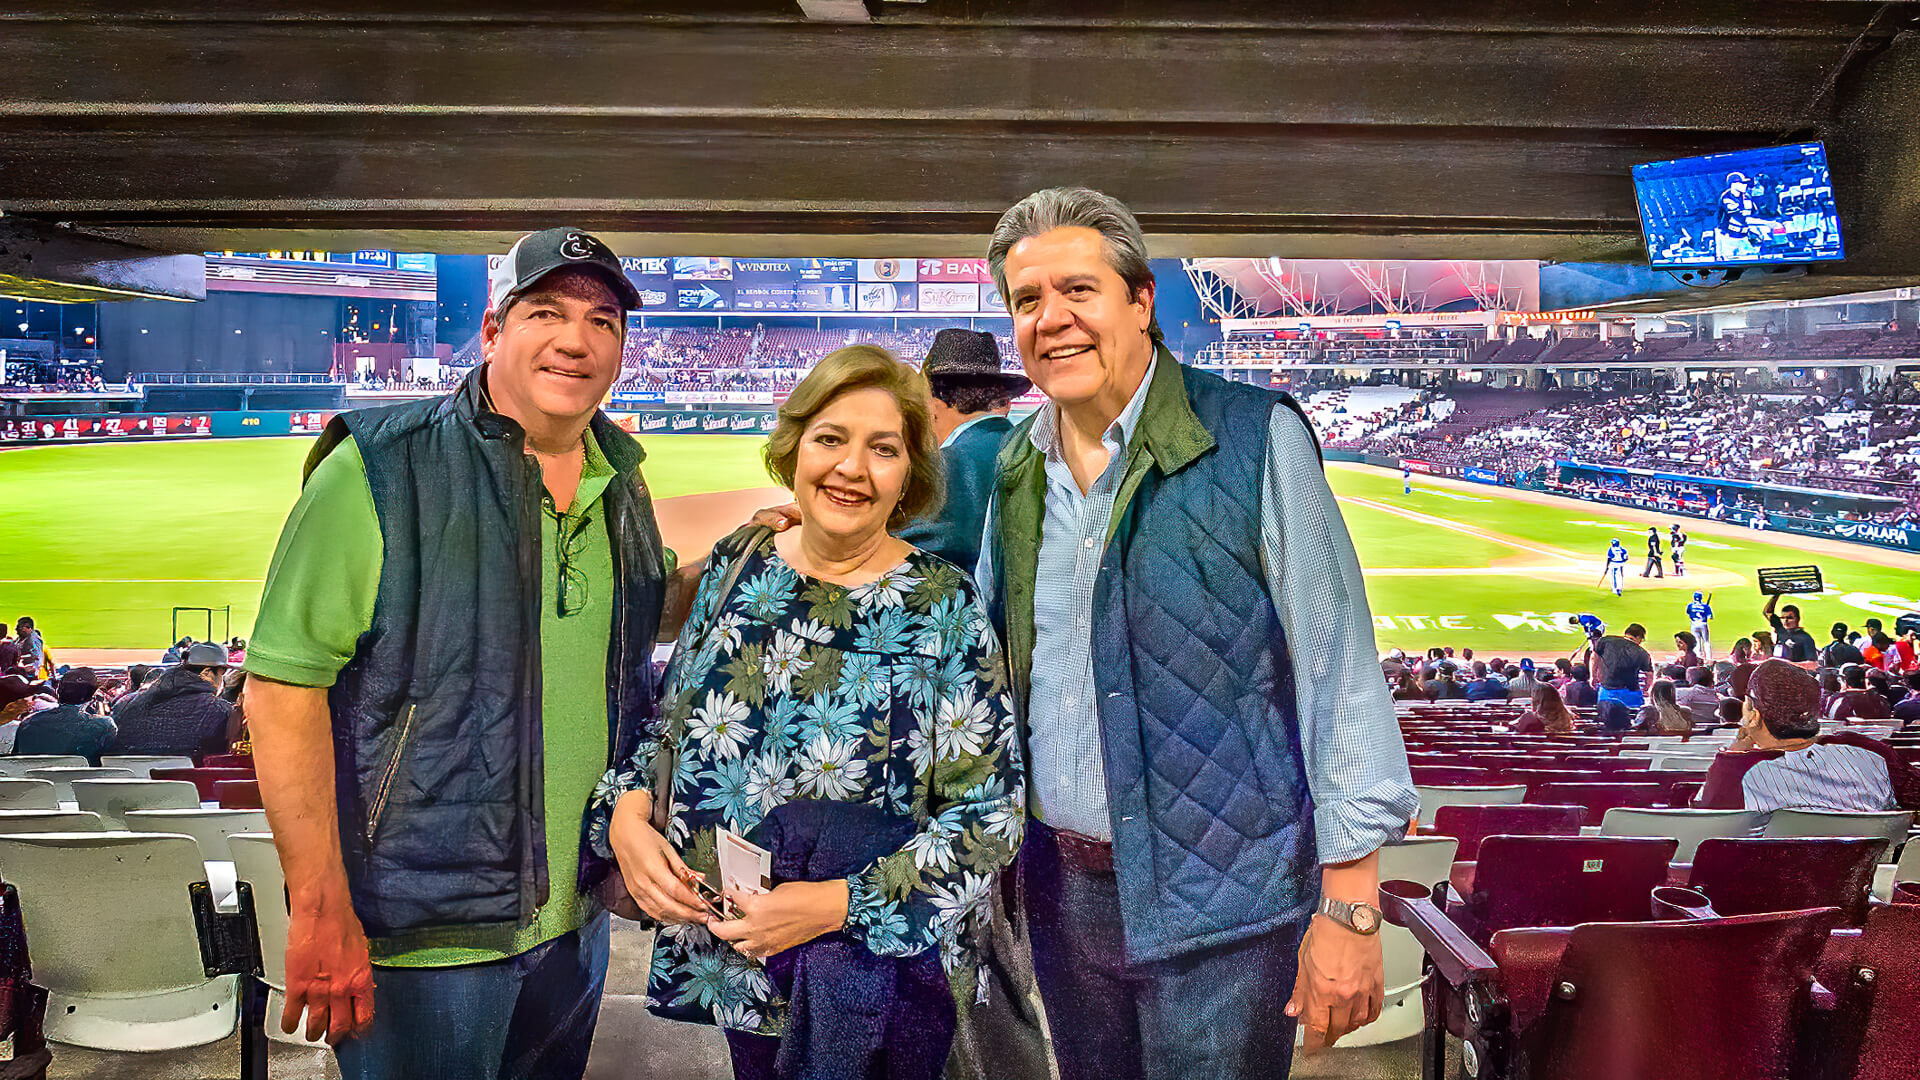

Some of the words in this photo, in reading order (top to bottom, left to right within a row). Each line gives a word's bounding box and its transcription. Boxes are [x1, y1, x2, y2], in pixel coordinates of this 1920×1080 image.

[620, 258, 668, 272] ARTEK
[746, 262, 791, 272] VINOTECA
[22, 421, 36, 432] 31
[63, 418, 79, 431] 41
[242, 417, 260, 426] 410
